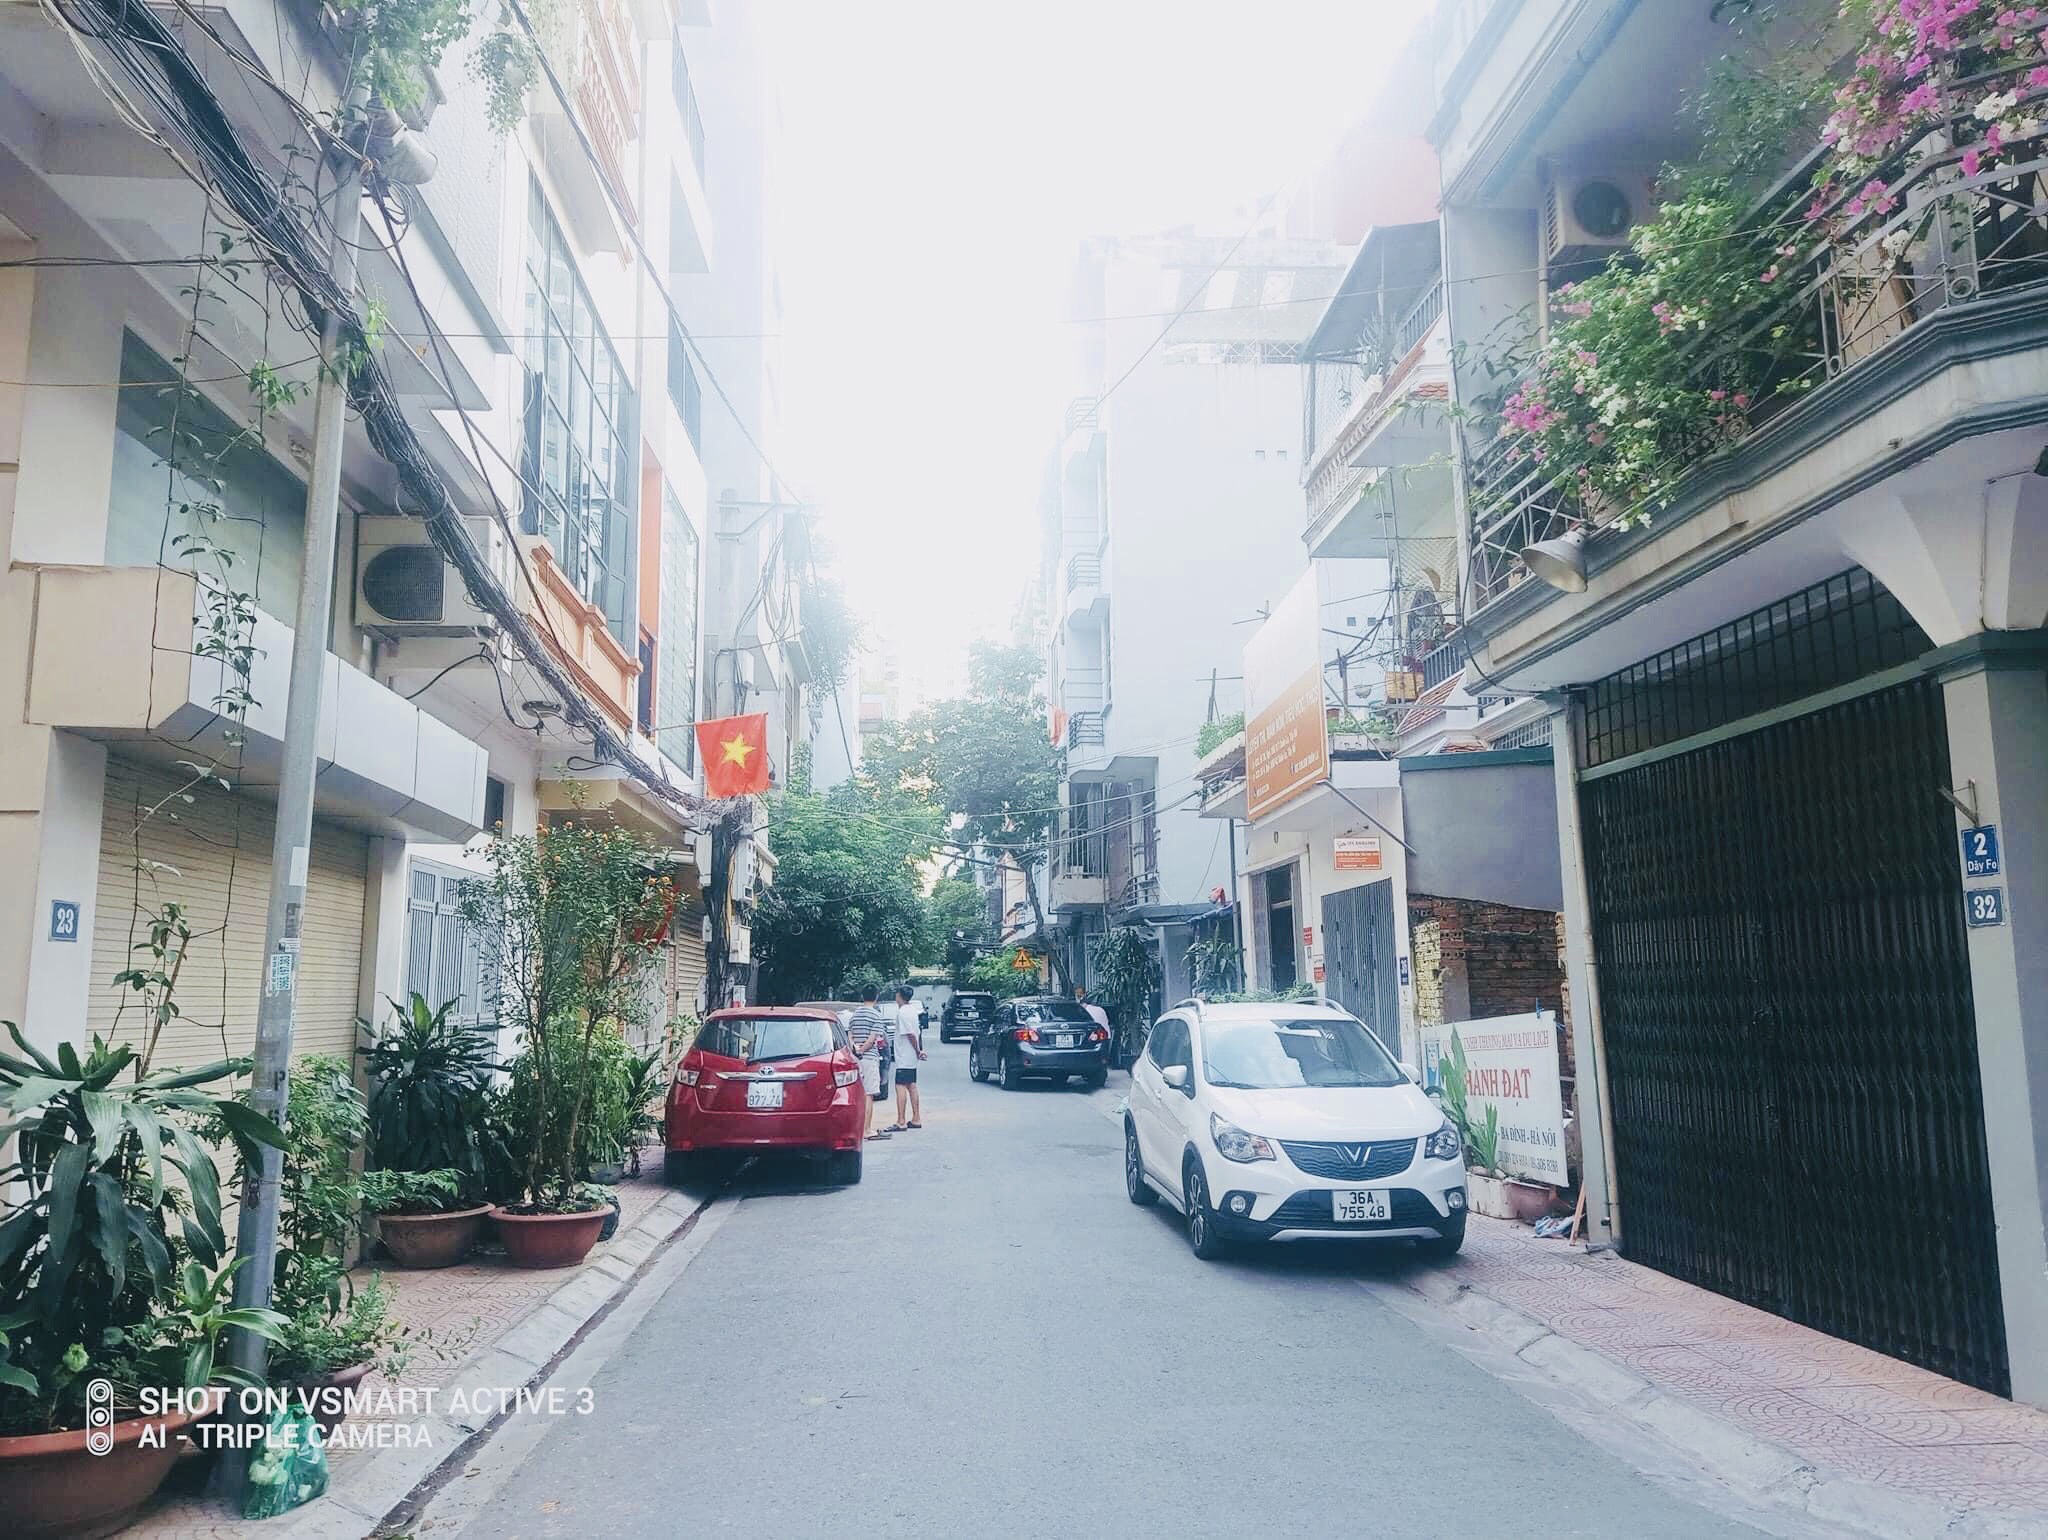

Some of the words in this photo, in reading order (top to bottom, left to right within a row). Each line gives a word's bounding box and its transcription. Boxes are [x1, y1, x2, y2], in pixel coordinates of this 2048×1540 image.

[1973, 832, 1988, 856] 2
[1973, 894, 1997, 919] 32
[56, 907, 75, 934] 23
[1464, 1061, 1499, 1097] HÀNH
[1502, 1068, 1531, 1107] ĐẠT
[1500, 1126, 1509, 1140] BA
[1530, 1126, 1541, 1145] HÀ
[1541, 1127, 1557, 1151] NỘI
[1349, 1191, 1374, 1204] 36A
[1339, 1206, 1385, 1219] 755.48
